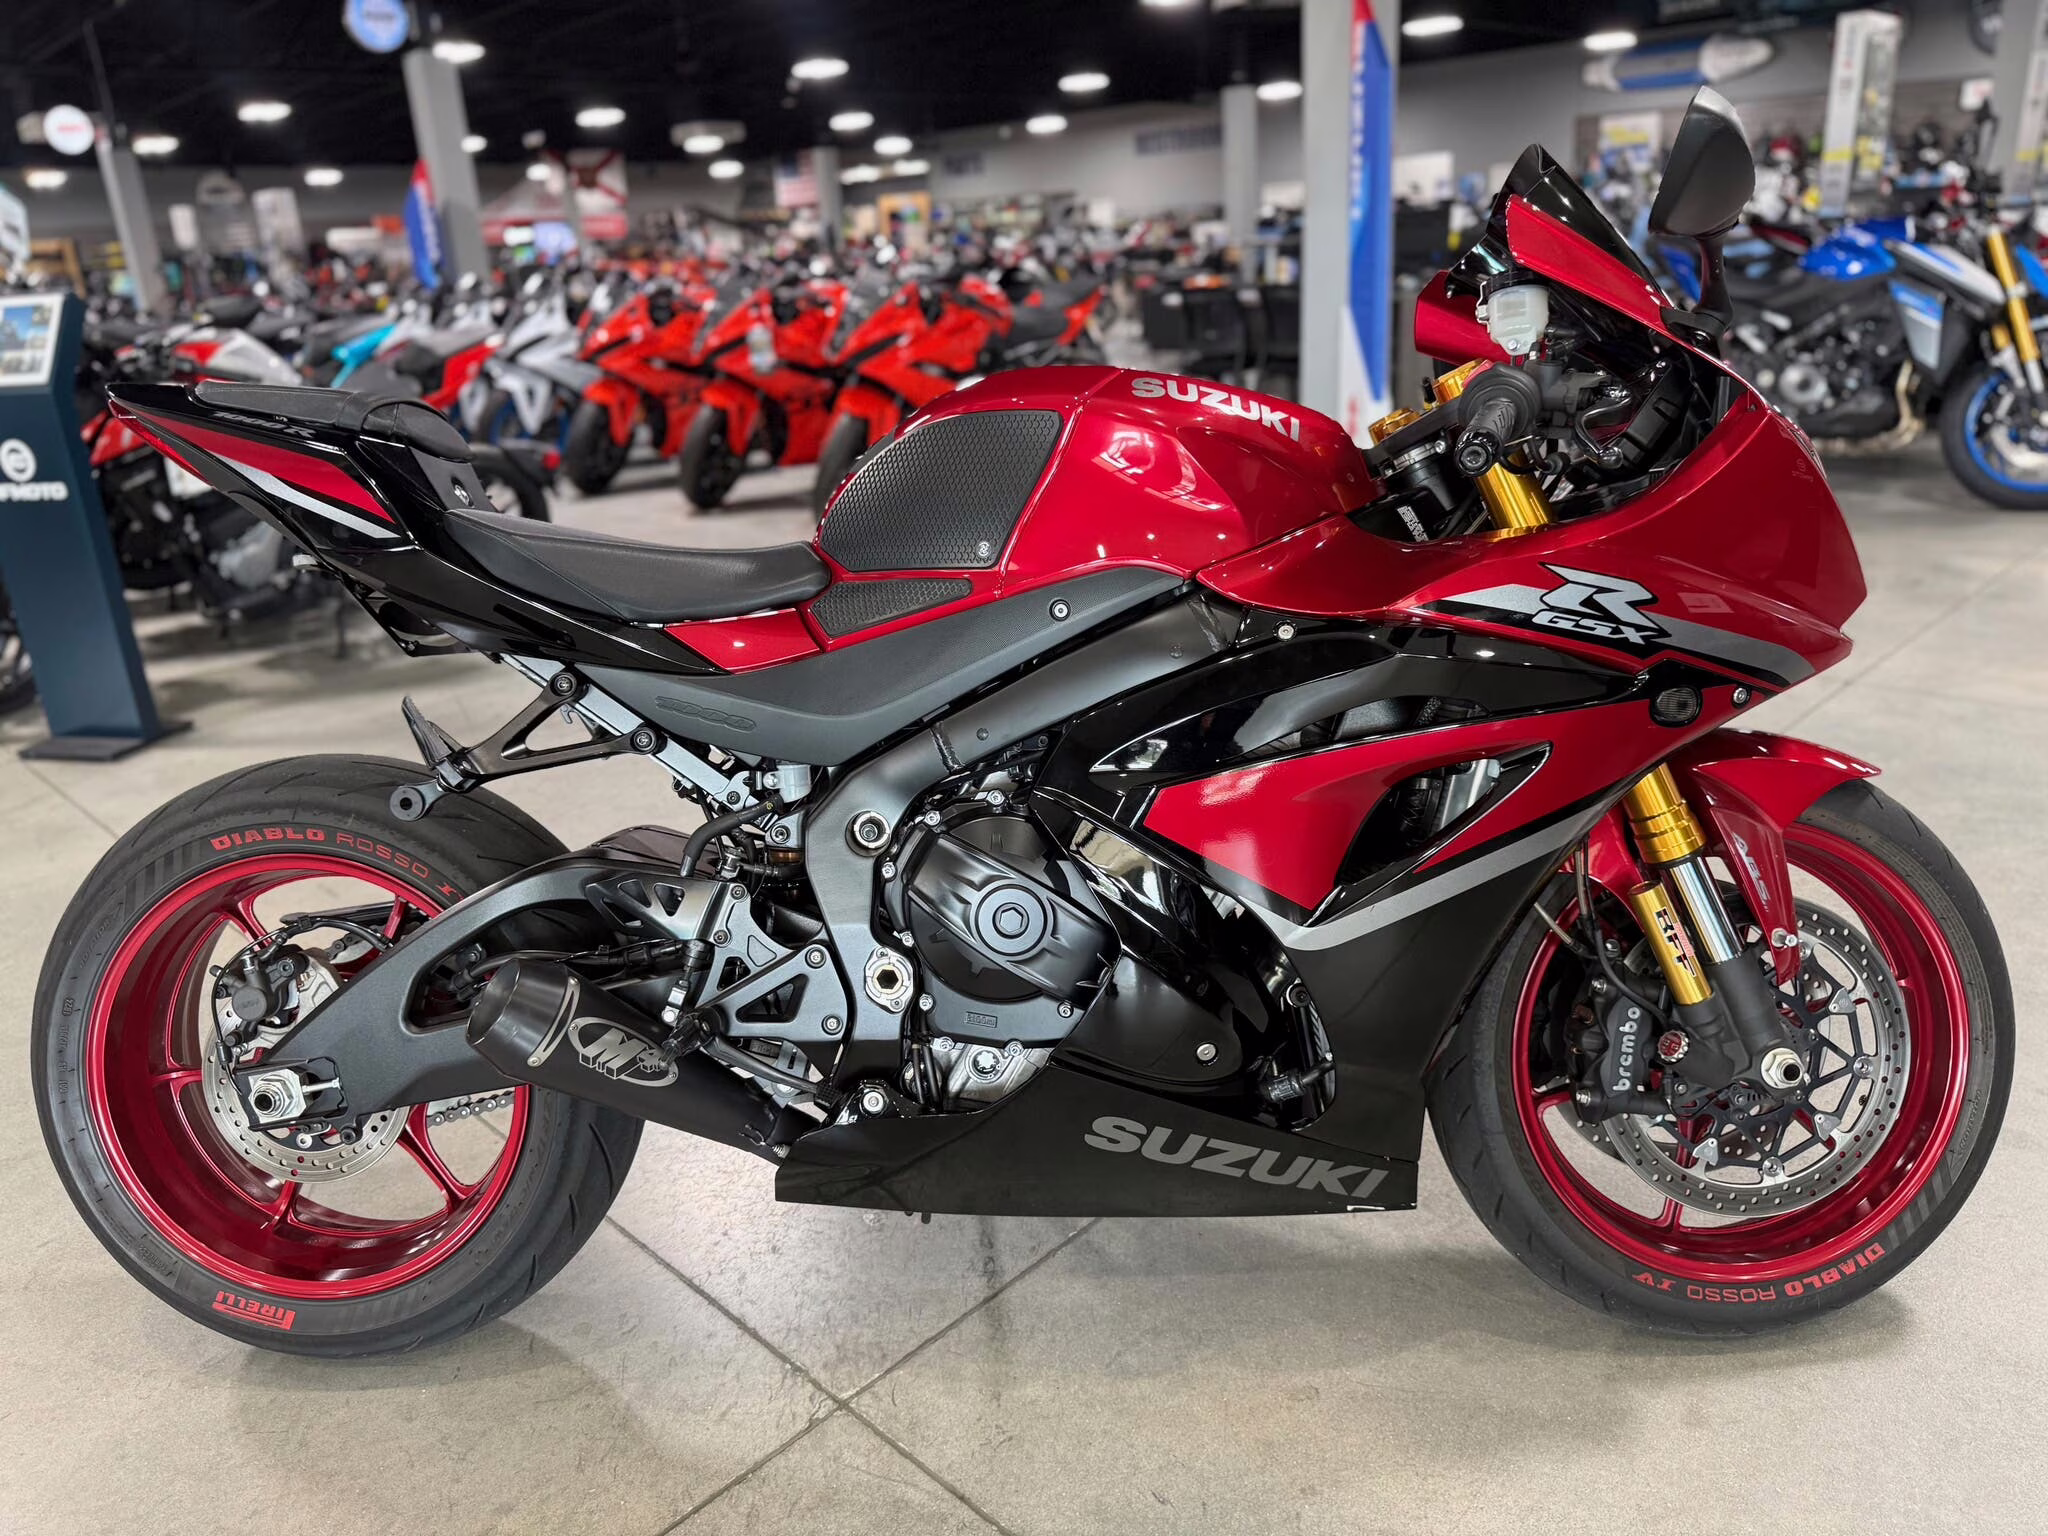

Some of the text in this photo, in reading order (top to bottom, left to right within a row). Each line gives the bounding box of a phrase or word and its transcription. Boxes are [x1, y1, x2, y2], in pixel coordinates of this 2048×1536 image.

[1131, 377, 1300, 442] SUZUKI
[1531, 609, 1660, 646] GSX
[210, 826, 327, 851] DIABLO
[335, 831, 430, 880] ROSSO
[1612, 1006, 1641, 1091] brembo
[1084, 1115, 1390, 1199] SUZUKI
[1686, 1284, 1777, 1303] ROSSO
[1784, 1241, 1886, 1297] DIABLO
[211, 1290, 297, 1332] PIRELLI
